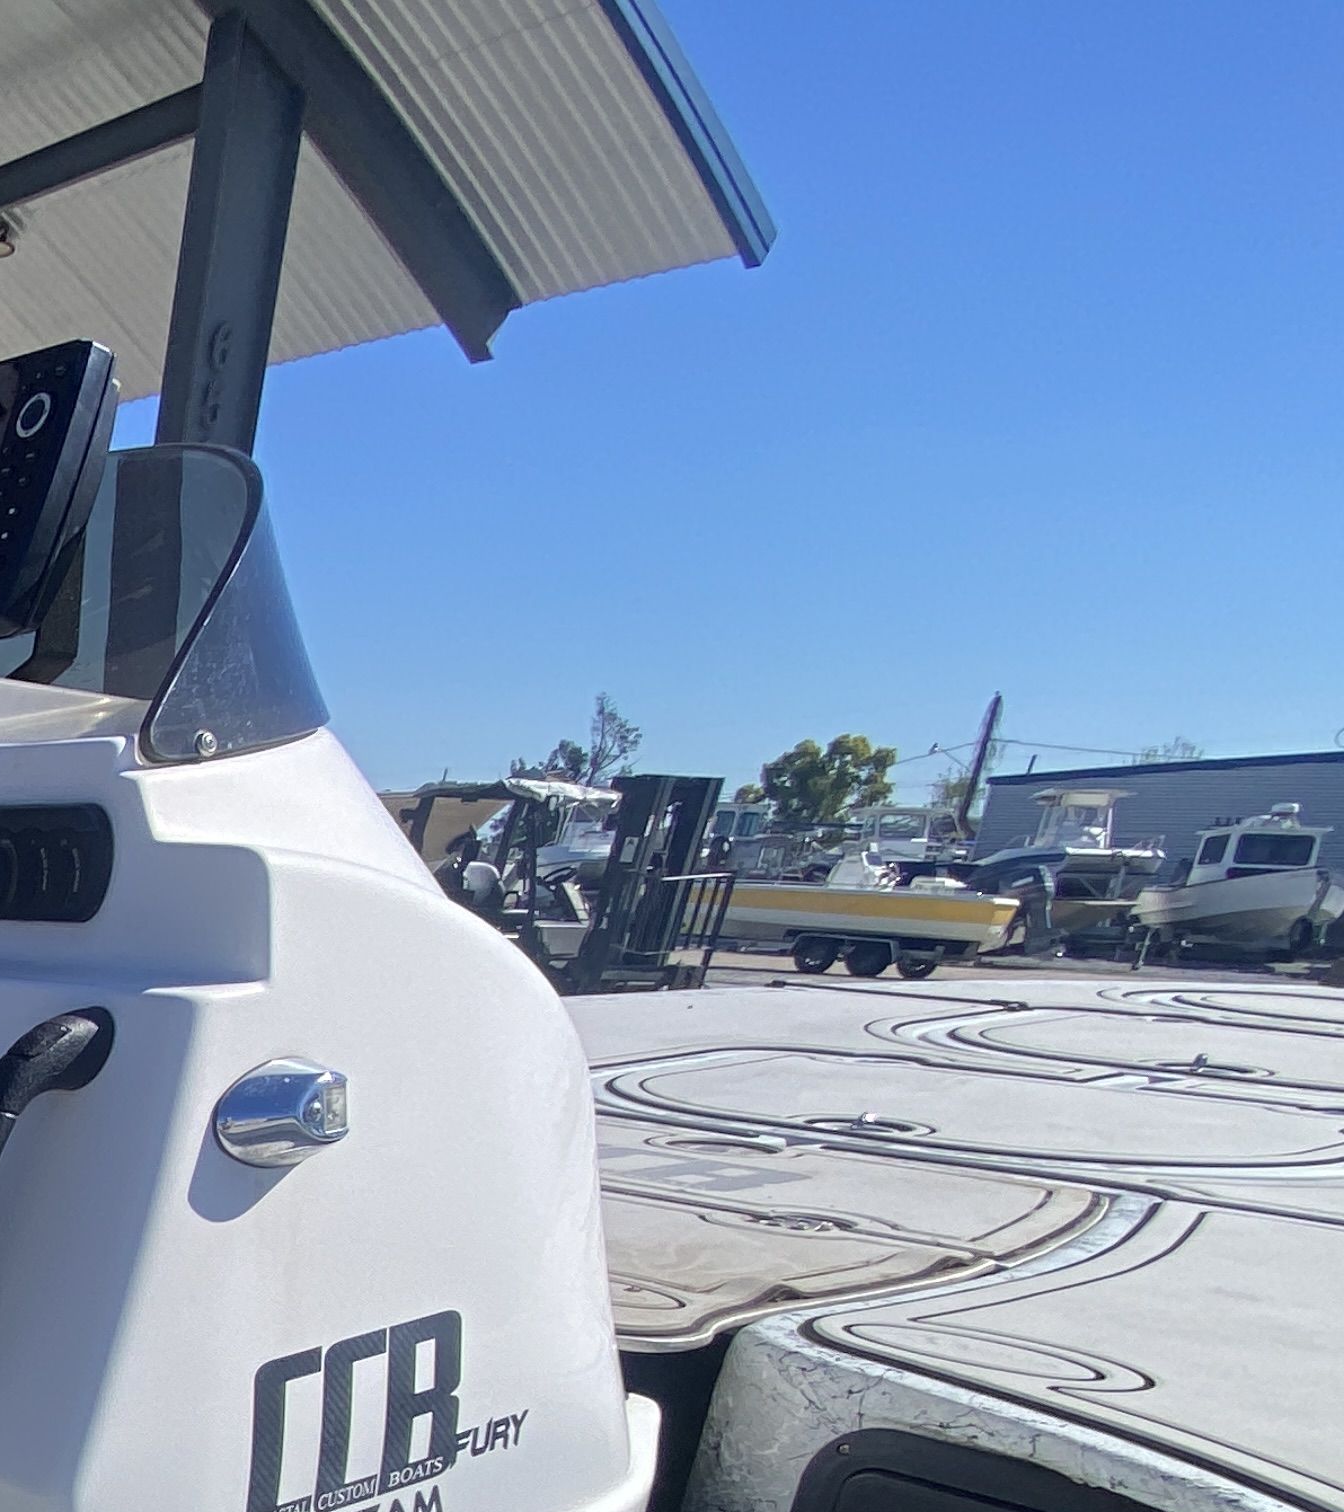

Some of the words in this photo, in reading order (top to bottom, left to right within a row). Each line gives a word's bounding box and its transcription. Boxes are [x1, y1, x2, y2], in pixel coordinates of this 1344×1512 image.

[454, 1409, 528, 1457] FURY
[317, 1478, 376, 1511] CUSTOM
[388, 1456, 444, 1488] BOATS
